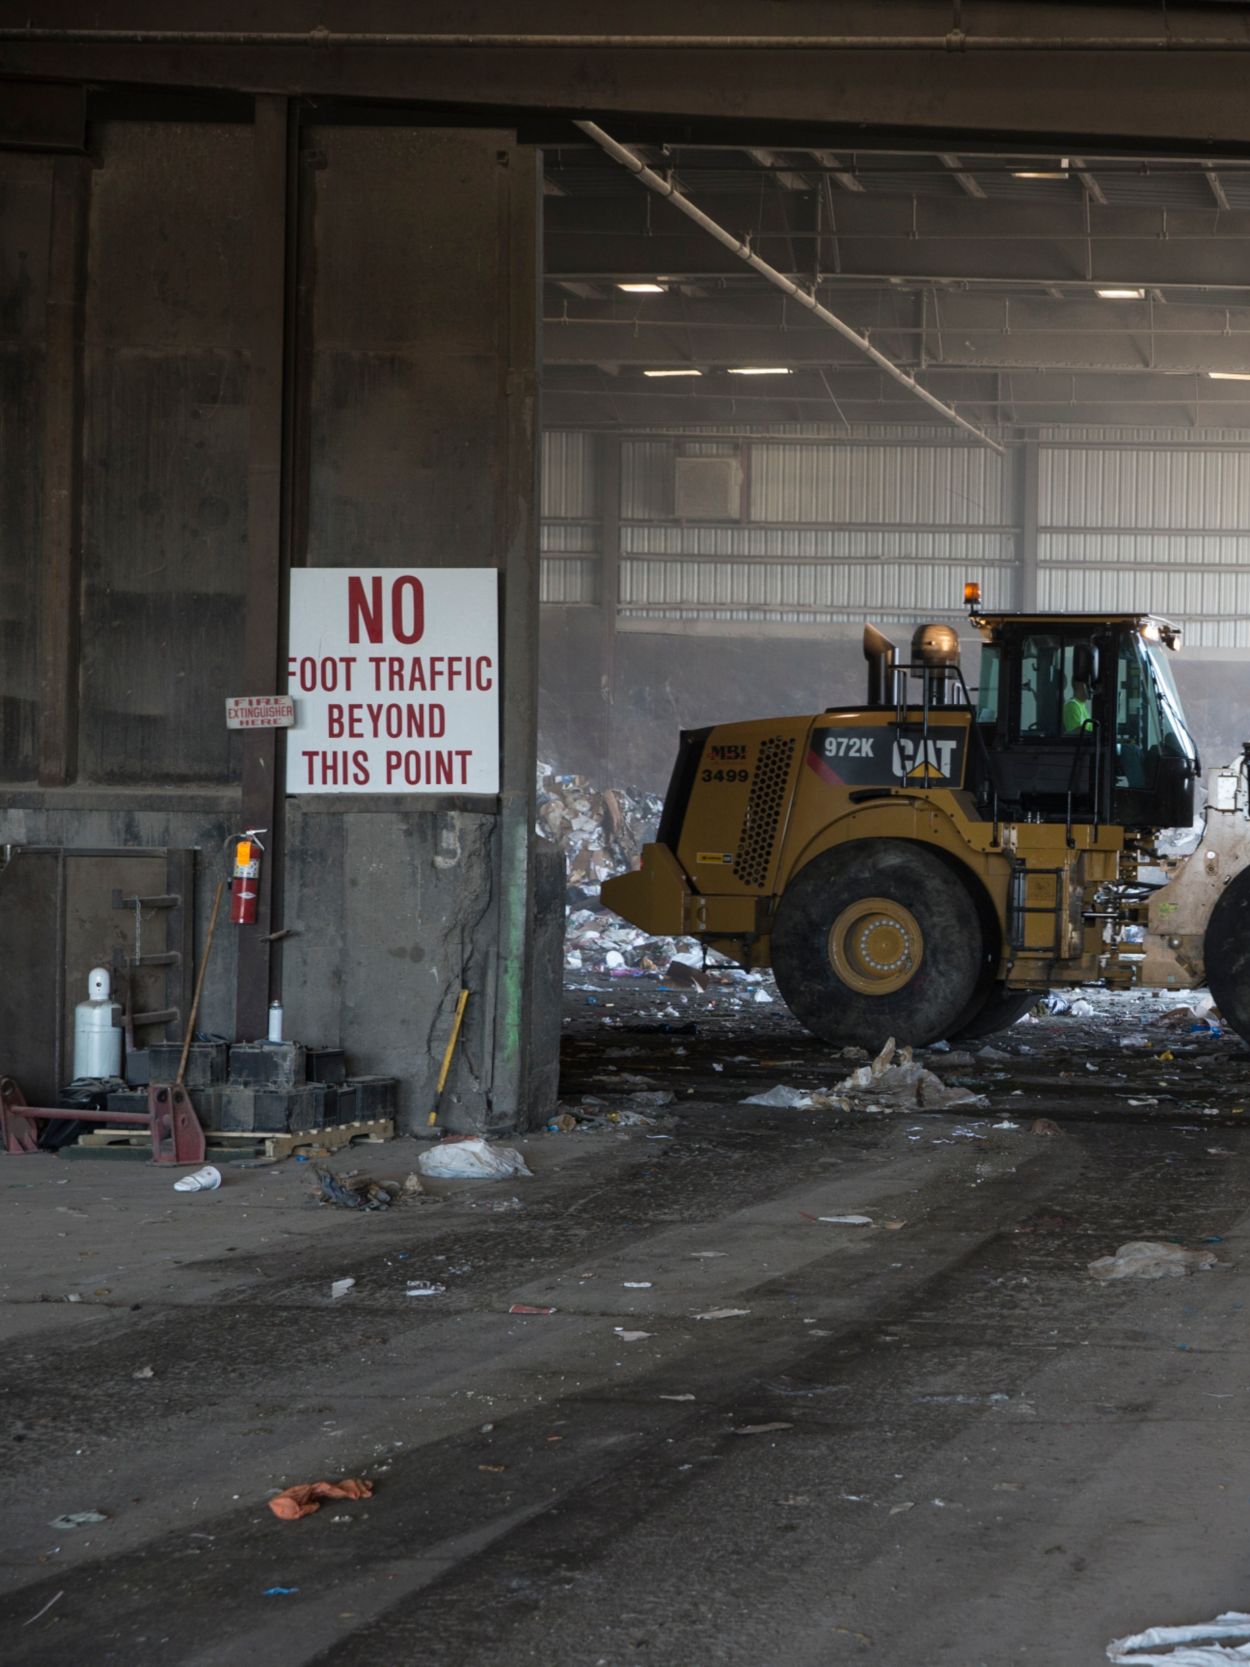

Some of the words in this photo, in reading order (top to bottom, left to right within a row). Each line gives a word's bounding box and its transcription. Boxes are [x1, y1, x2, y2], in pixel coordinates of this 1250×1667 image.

[348, 575, 425, 645] NO
[369, 655, 493, 692] TRAFFIC
[228, 706, 293, 719] EXTINGUISHER
[328, 703, 446, 739] BEYOND
[824, 737, 875, 758] 972K
[892, 738, 957, 779] CAT
[302, 750, 371, 786] THIS
[385, 750, 473, 786] POINT
[701, 768, 749, 783] 3499
